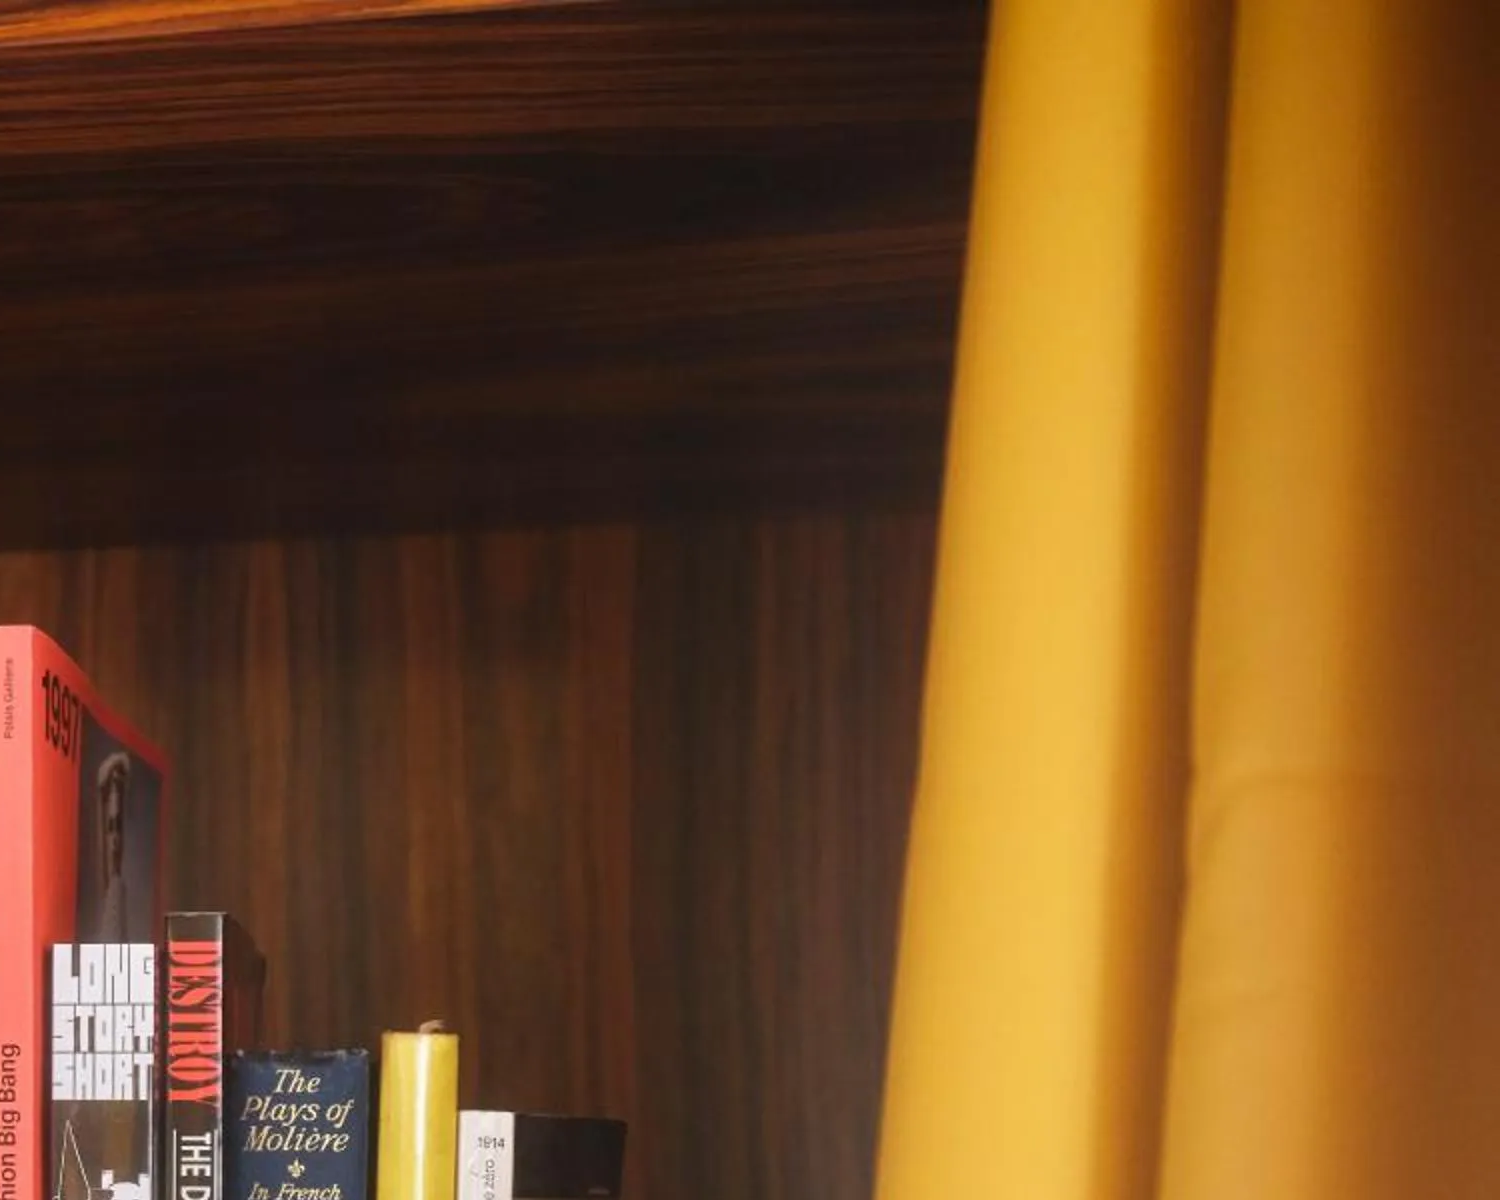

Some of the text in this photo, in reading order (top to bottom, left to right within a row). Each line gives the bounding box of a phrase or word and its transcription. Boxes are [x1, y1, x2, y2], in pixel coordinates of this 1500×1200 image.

[41, 668, 80, 764] 1997
[52, 943, 154, 1005] LONG
[52, 1005, 154, 1053] STORY
[167, 941, 220, 1107] DESTROY
[52, 1053, 154, 1100] SHORT
[274, 1069, 320, 1094] The
[242, 1097, 353, 1127] Plays of
[180, 1133, 211, 1181] THE
[243, 1126, 348, 1153] Molière
[248, 1184, 271, 1200] In
